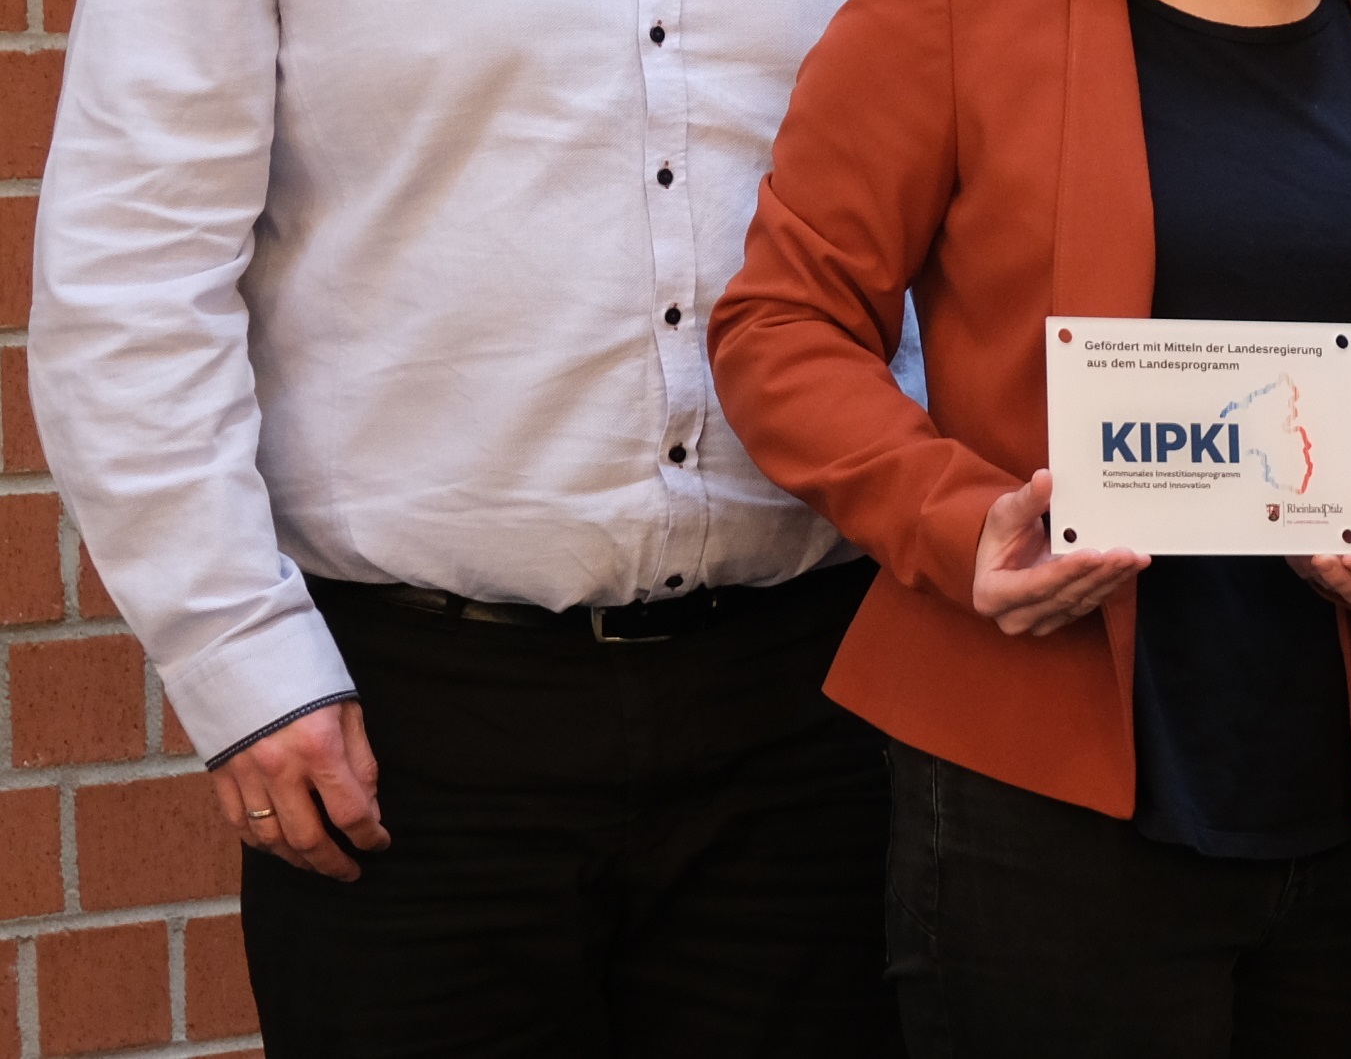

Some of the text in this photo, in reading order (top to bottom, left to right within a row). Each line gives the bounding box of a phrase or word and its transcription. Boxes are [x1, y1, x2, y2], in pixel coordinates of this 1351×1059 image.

[1085, 341, 1322, 357] Gefördert mit Mitteln der Landesregierung
[1087, 358, 1239, 371] aus dem Landesprogramm
[1102, 422, 1239, 464] KIPKI
[1102, 470, 1240, 479] Kommunales Investitionsprogramm
[1103, 481, 1211, 489] Klimaschutz und Innovation
